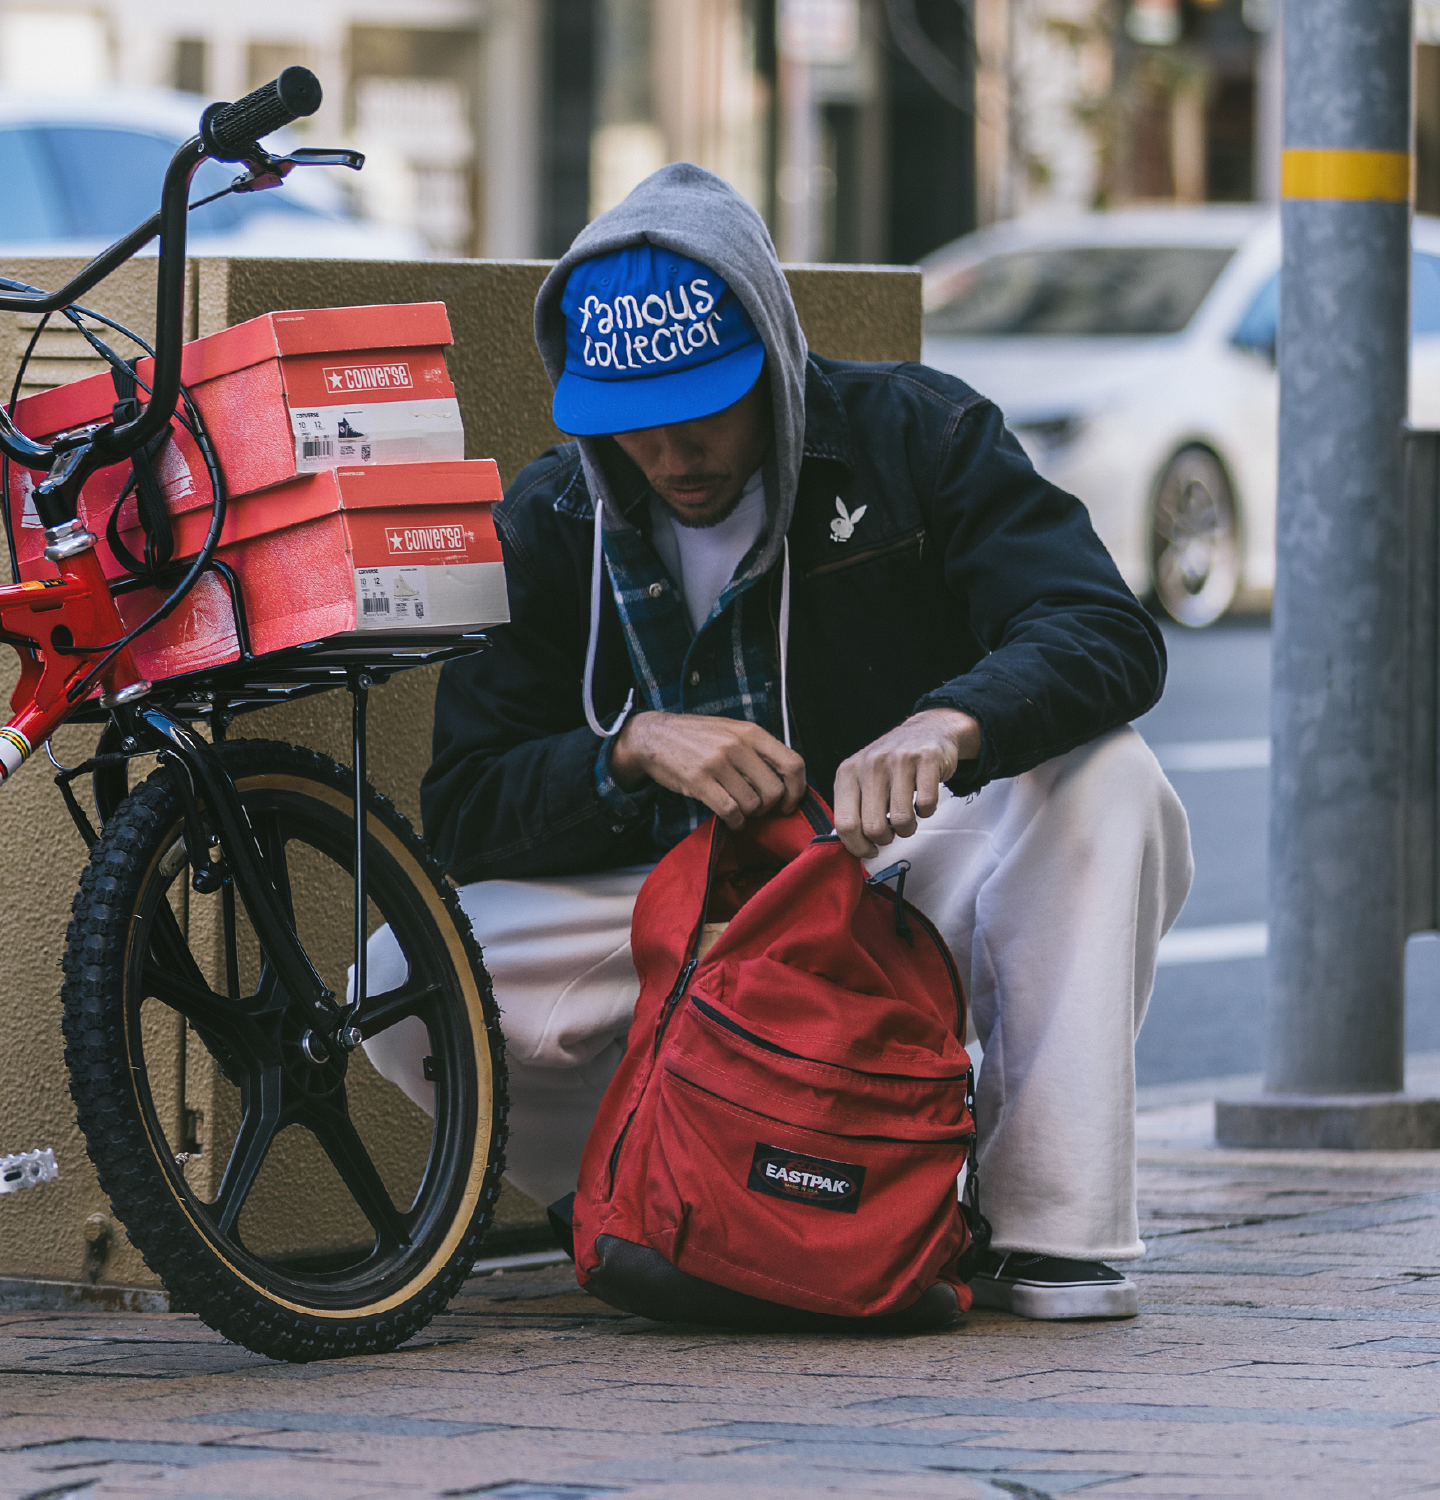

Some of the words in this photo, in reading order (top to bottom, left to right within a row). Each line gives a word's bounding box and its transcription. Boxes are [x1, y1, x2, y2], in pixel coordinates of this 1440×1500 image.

[579, 279, 714, 334] famous
[583, 311, 723, 370] collector
[298, 421, 307, 429] 10
[314, 420, 322, 428] 12
[373, 577, 381, 585] 12
